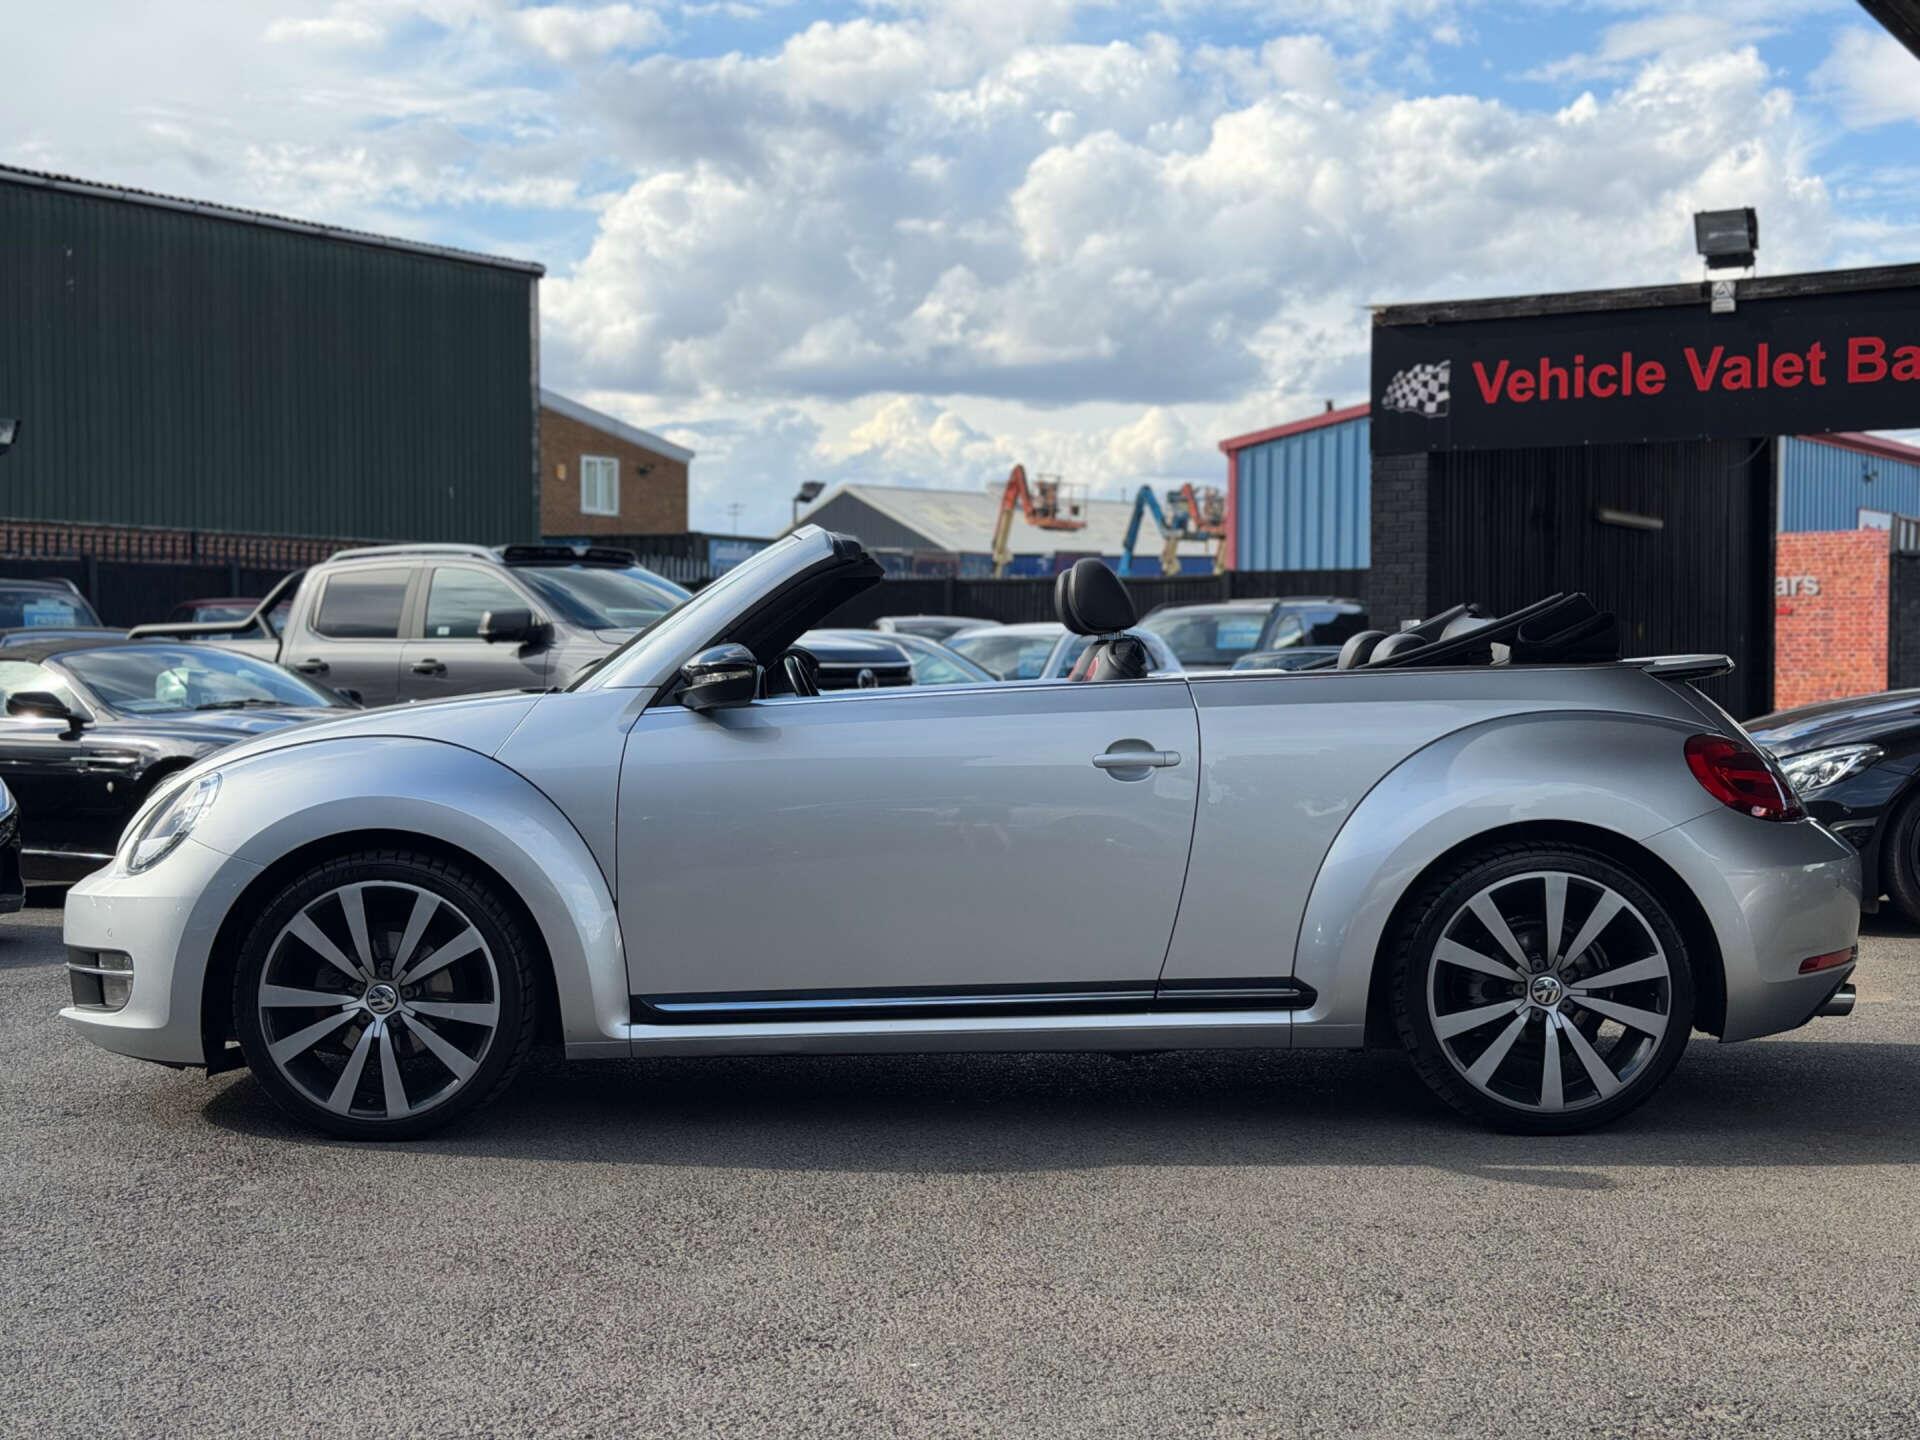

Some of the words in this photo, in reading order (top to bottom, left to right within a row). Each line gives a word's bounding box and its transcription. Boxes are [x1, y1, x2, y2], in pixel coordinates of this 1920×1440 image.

[1472, 351, 1666, 404] Vehicle
[1684, 341, 1827, 392] Valet
[1847, 336, 1920, 384] Ba
